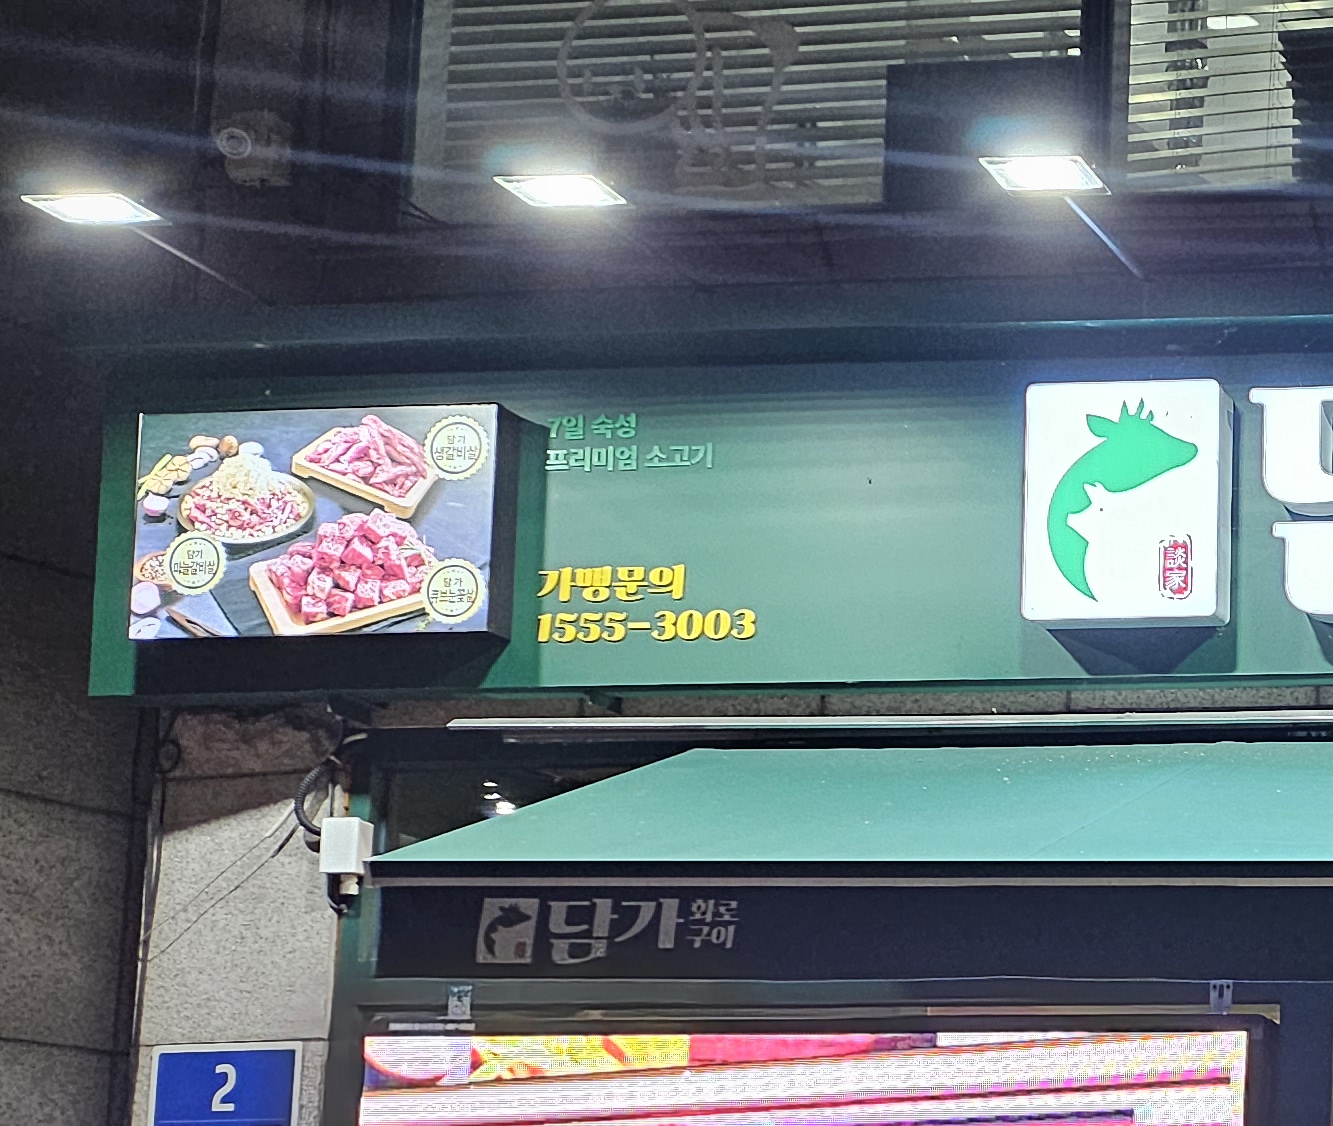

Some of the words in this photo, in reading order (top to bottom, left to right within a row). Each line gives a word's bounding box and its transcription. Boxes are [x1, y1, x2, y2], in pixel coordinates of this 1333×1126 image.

[548, 413, 585, 439] 7일
[591, 412, 637, 439] 숙성
[434, 446, 479, 461] 생갈비살
[544, 445, 638, 472] 프리미엄
[644, 441, 714, 468] 소고기
[172, 560, 216, 576] 마늘갈비살
[536, 563, 686, 602] 가맹문의
[536, 608, 757, 642] 1555-3003
[689, 899, 740, 922] 화로
[549, 898, 685, 964] 담가
[686, 924, 738, 949] 구이
[211, 1063, 238, 1112] 2
